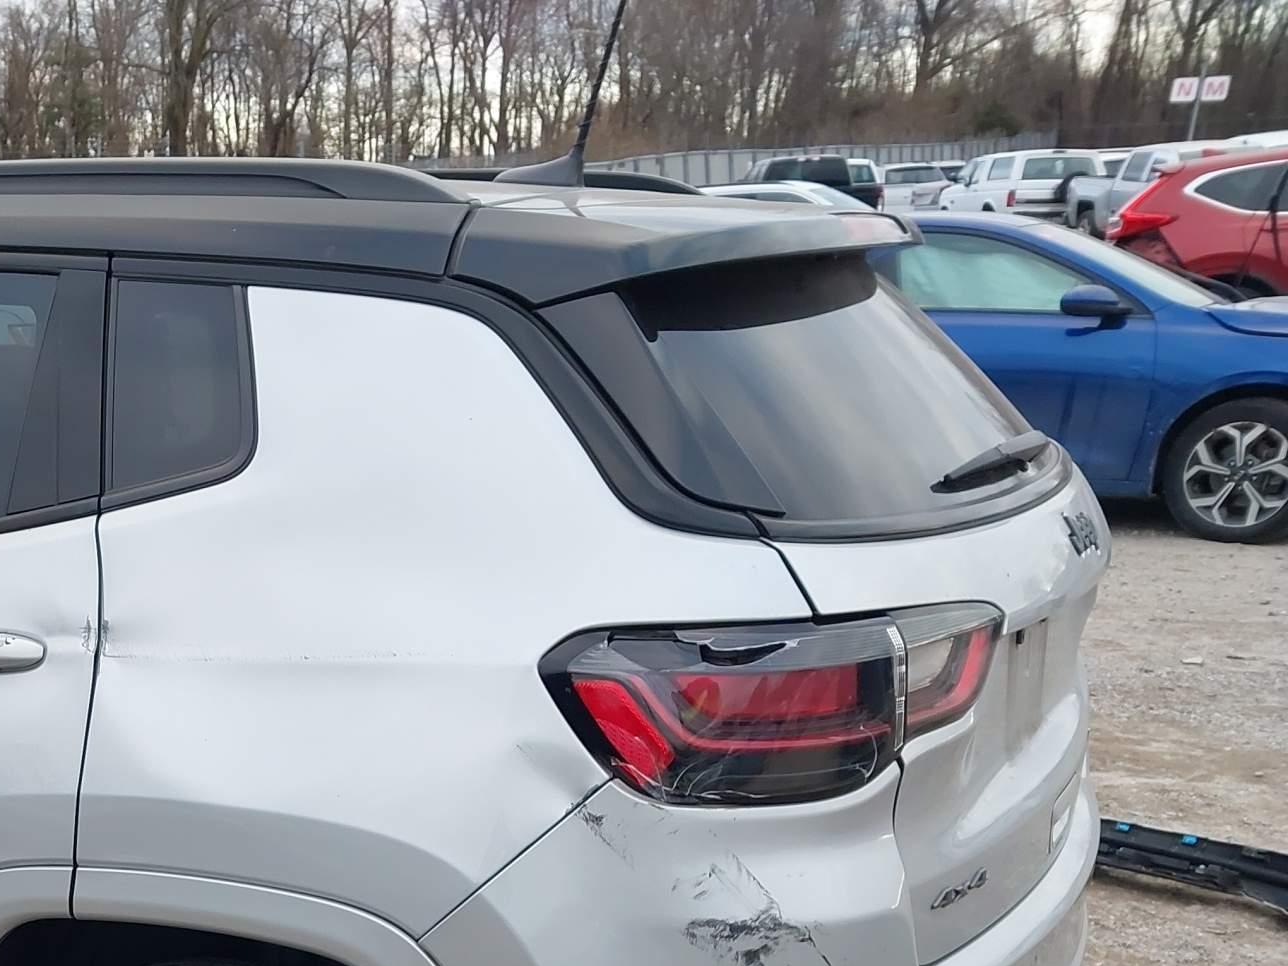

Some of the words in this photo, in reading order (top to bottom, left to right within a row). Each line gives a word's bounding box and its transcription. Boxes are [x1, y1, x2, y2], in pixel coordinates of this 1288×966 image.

[1177, 82, 1193, 97] N
[1205, 81, 1225, 97] M
[1061, 512, 1099, 556] Jeep
